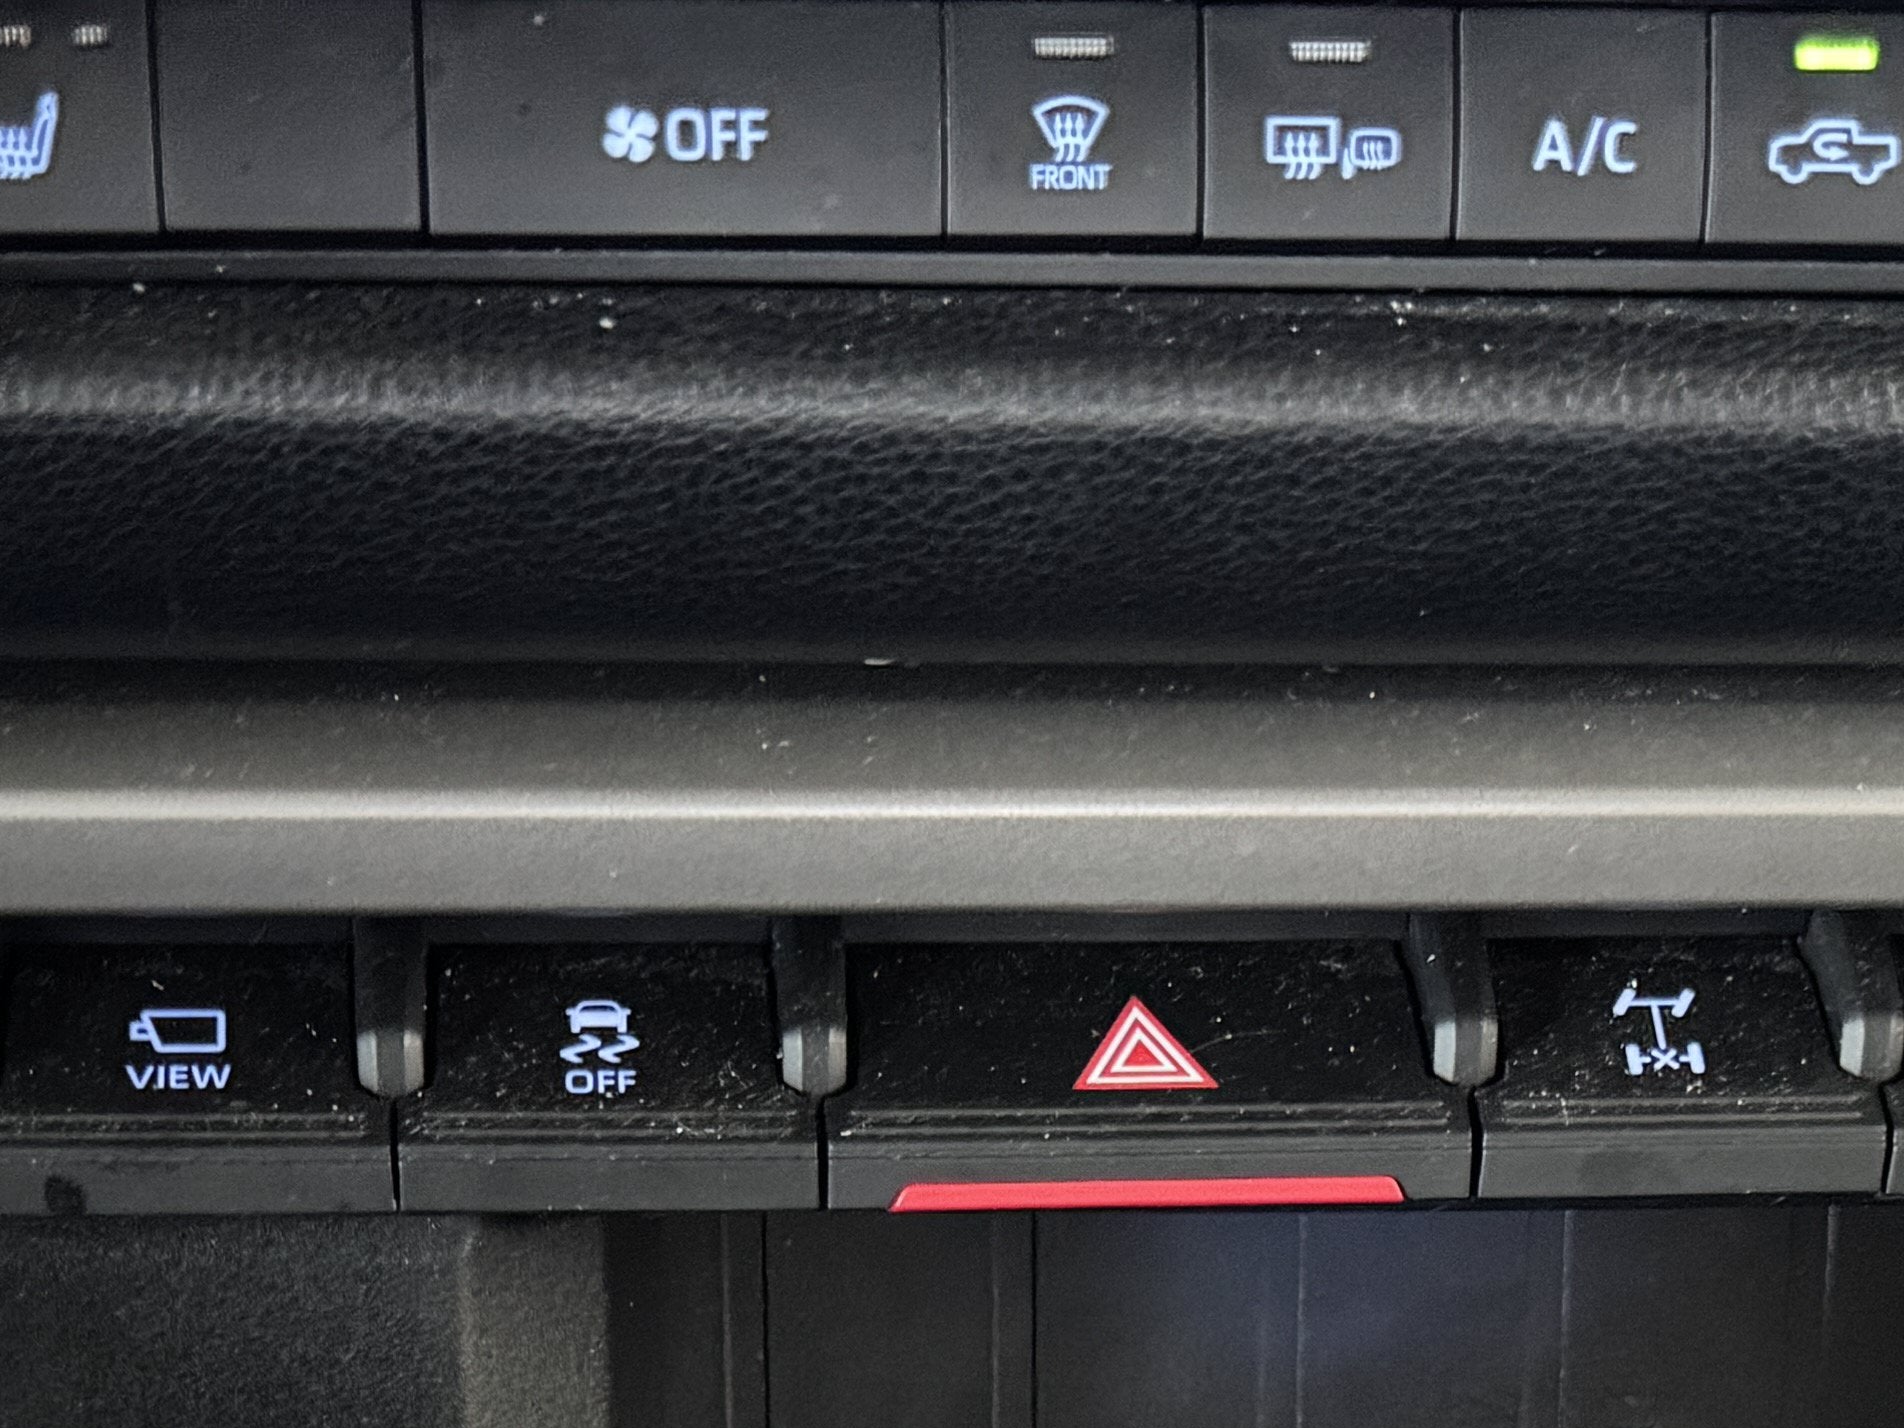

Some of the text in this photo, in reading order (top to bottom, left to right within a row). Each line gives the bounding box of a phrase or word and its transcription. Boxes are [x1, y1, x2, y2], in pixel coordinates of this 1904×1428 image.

[665, 105, 770, 162] OFF
[1530, 114, 1639, 177] A/C
[1029, 162, 1113, 190] FRONT
[124, 1062, 232, 1090] VIEW
[564, 1068, 637, 1095] OFF
